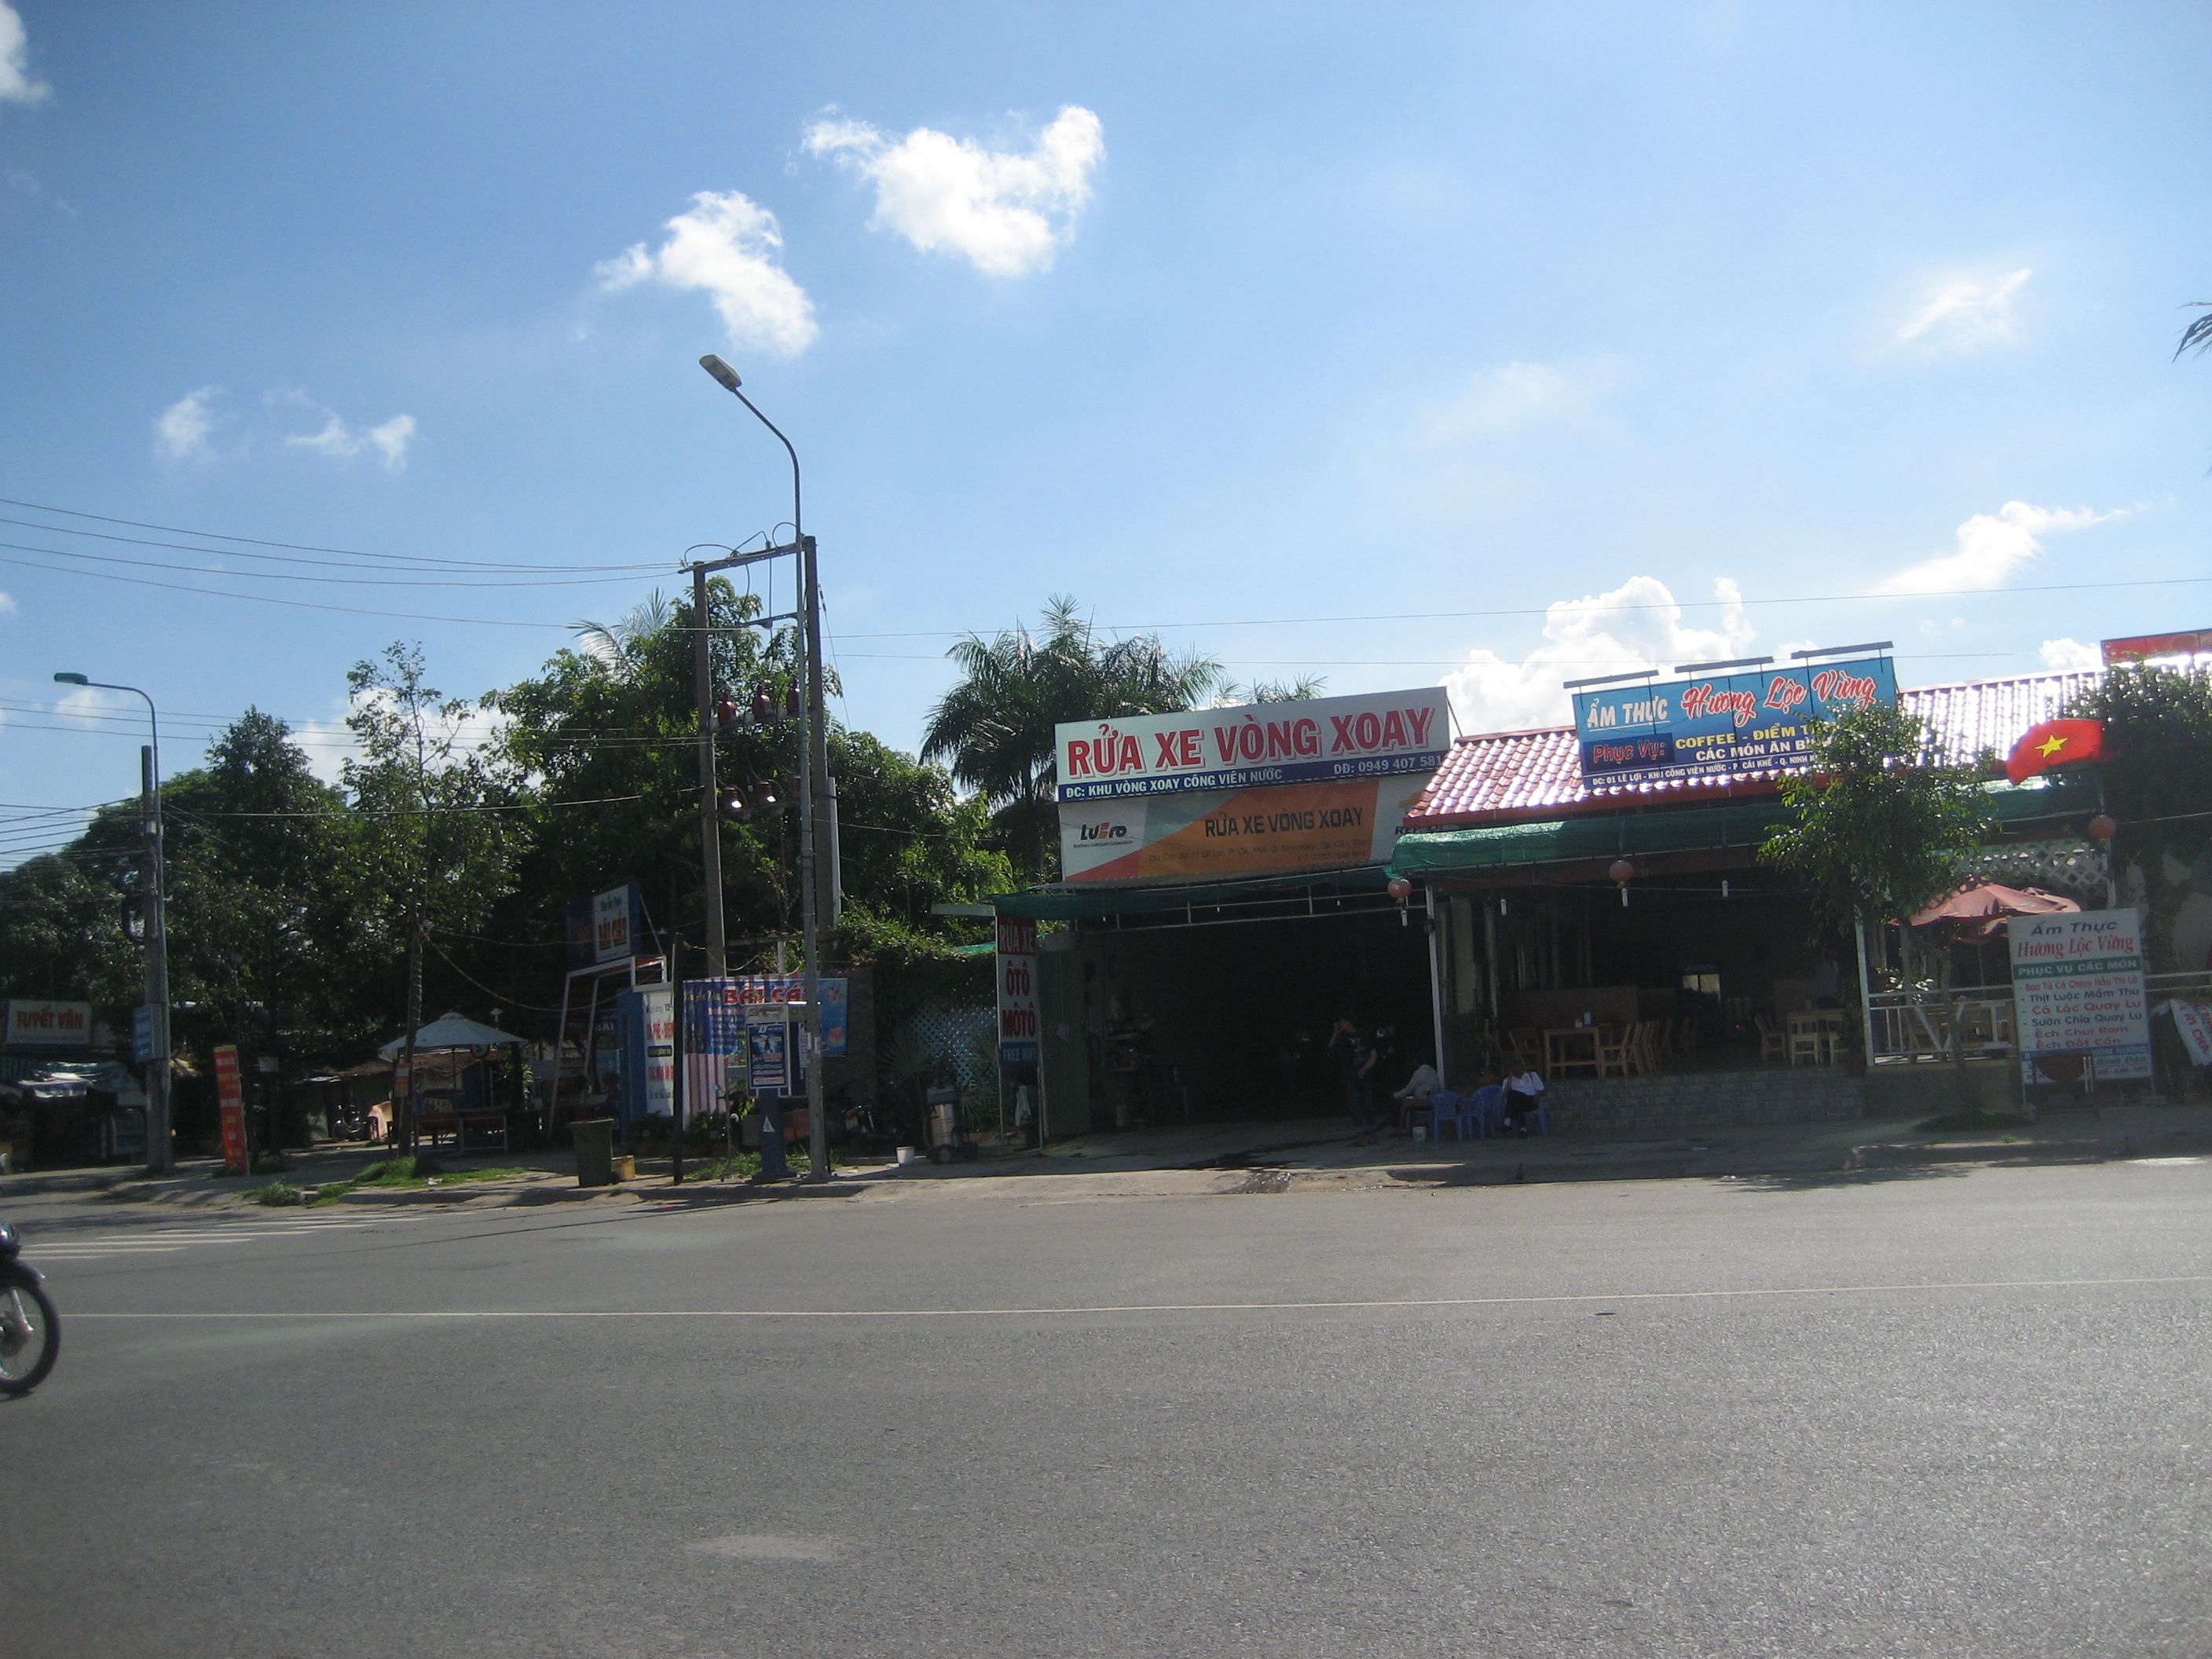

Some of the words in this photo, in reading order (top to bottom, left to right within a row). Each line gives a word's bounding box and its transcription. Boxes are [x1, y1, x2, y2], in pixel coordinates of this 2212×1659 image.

[1587, 698, 1616, 728] ẨM
[1622, 695, 1668, 725] THỰC
[1682, 684, 1758, 727] Hương
[1763, 676, 1809, 714] Lộc
[1811, 670, 1877, 713] Vừng
[1068, 723, 1148, 779] RỬA
[1154, 729, 1207, 771] XE
[1214, 713, 1323, 767] VÒNG
[1329, 707, 1437, 756] XOAY
[1675, 733, 1736, 750] COFFEE
[1752, 722, 1796, 742] ĐIỂM
[1696, 745, 1726, 762] CÁC
[1730, 742, 1767, 759] MÓN
[1770, 736, 1792, 753] ĂN
[1334, 763, 1354, 775] DĐ:
[1358, 760, 1389, 773] 0949
[1393, 757, 1415, 771] 407
[1419, 754, 1442, 767] 581
[1593, 744, 1635, 765] Phục
[1638, 739, 1666, 761] Vụ:
[1066, 786, 1086, 799] ĐC:
[1089, 784, 1112, 797] KHU
[1116, 778, 1147, 794] VÒNG
[1149, 778, 1181, 792] XOAY
[1184, 771, 1216, 789] CÔNG
[1220, 769, 1247, 786] VIÊN
[1251, 767, 1283, 783] NƯỚC
[1606, 775, 1617, 785] 01
[1617, 772, 1628, 783] LÊ
[1648, 770, 1664, 781] KHU
[1665, 767, 1686, 779] CÔNG
[1686, 764, 1705, 775] VIÊN
[1706, 761, 1727, 774] NƯỚC
[1742, 759, 1756, 770] CÁI
[1779, 758, 1788, 767] Q.
[1789, 754, 1808, 765] NINH
[1205, 811, 1240, 838] RỬA
[1243, 815, 1265, 834] XE
[1268, 808, 1316, 833] VÒNG
[1319, 806, 1364, 829] XOAY
[2070, 921, 2117, 934] Thực
[2016, 941, 2065, 960] Hương
[2068, 936, 2093, 958] Lộc
[2098, 932, 2136, 954] Vừng
[1005, 959, 1031, 997] ÔTÔ
[2018, 965, 2053, 977] PHỤC
[2056, 965, 2073, 975] VỤ
[2078, 959, 2103, 972] CÁC
[2107, 958, 2137, 969] MÓN
[2030, 994, 2050, 1004] Thịt
[2053, 991, 2080, 1002] Luộc
[2119, 987, 2139, 996] Thu
[2032, 1005, 2050, 1015] Cá
[2084, 1002, 2120, 1013] Quay
[2126, 999, 2141, 1009] Lu
[1002, 1001, 1036, 1038] MÔTÔ
[2031, 1016, 2060, 1027] Sườn
[2094, 1013, 2125, 1024] Quay
[2129, 1011, 2142, 1020] Lu
[2064, 1027, 2093, 1037] Chui
